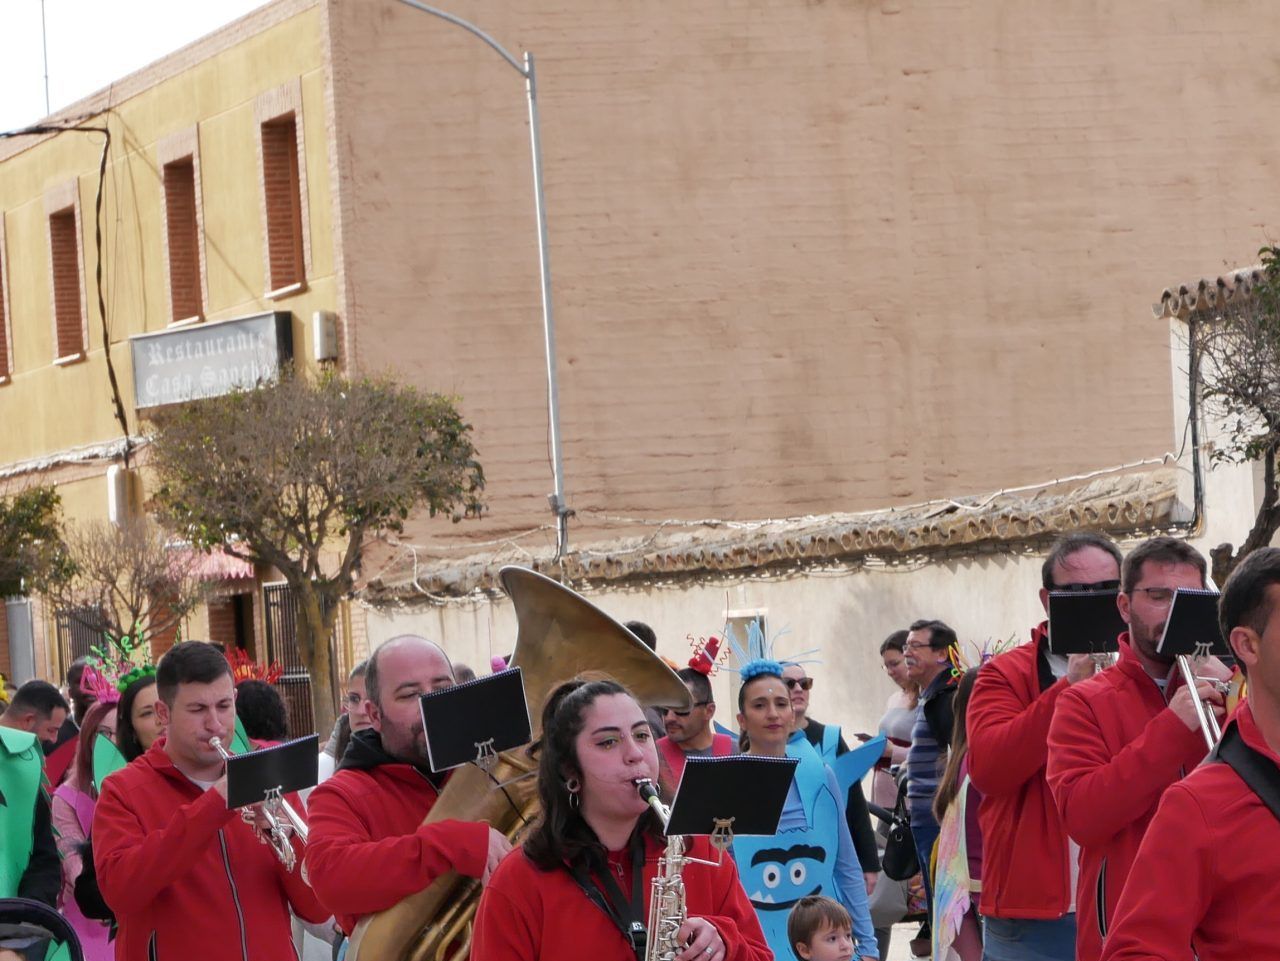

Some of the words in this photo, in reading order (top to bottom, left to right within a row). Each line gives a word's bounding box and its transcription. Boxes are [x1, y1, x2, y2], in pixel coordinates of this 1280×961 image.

[147, 332, 265, 367] Restaurante
[145, 373, 192, 397] Casa
[200, 360, 271, 387] Sancho
